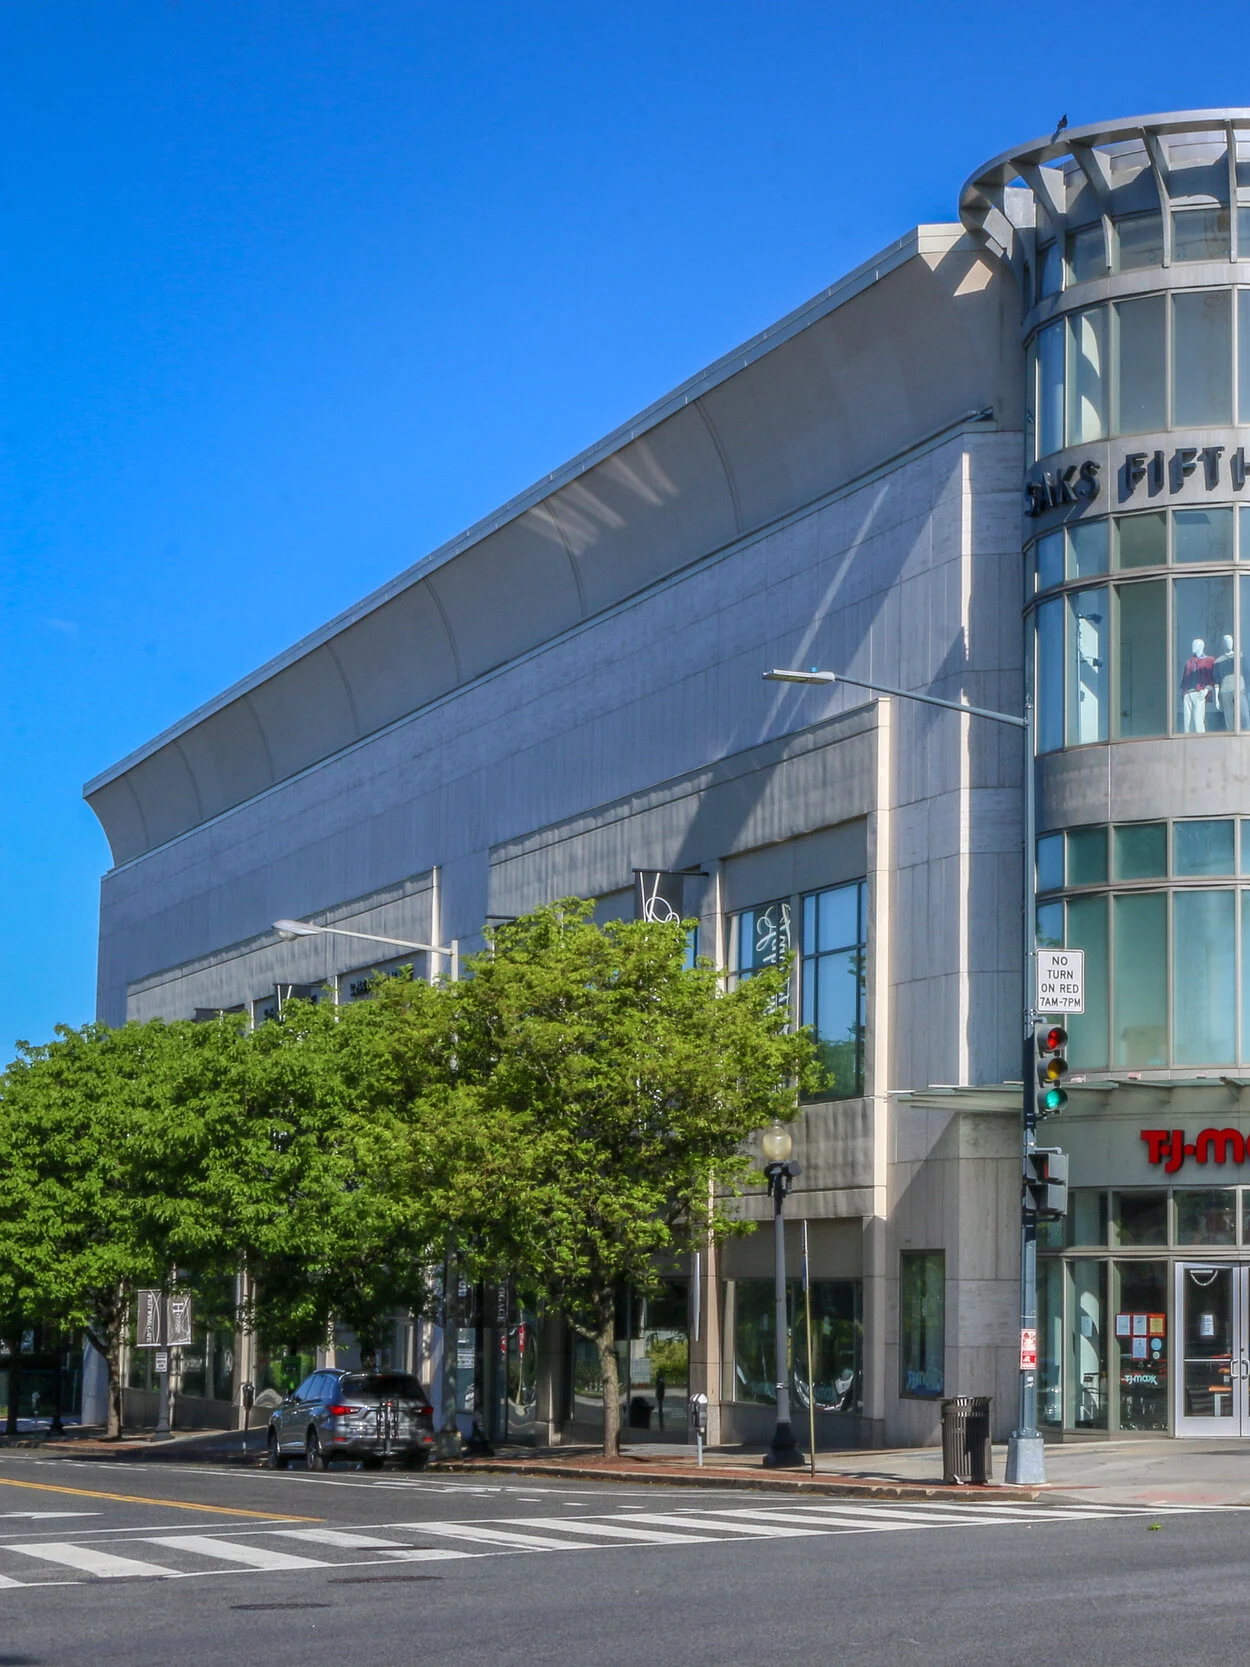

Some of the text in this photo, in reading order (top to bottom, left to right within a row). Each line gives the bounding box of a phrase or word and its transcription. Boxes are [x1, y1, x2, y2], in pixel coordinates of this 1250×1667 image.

[1024, 461, 1101, 517] SAKS
[1052, 956, 1068, 966] NO
[1047, 970, 1074, 979] TURN
[1041, 983, 1079, 993] ON RED
[1040, 997, 1081, 1007] 7AM-7PM
